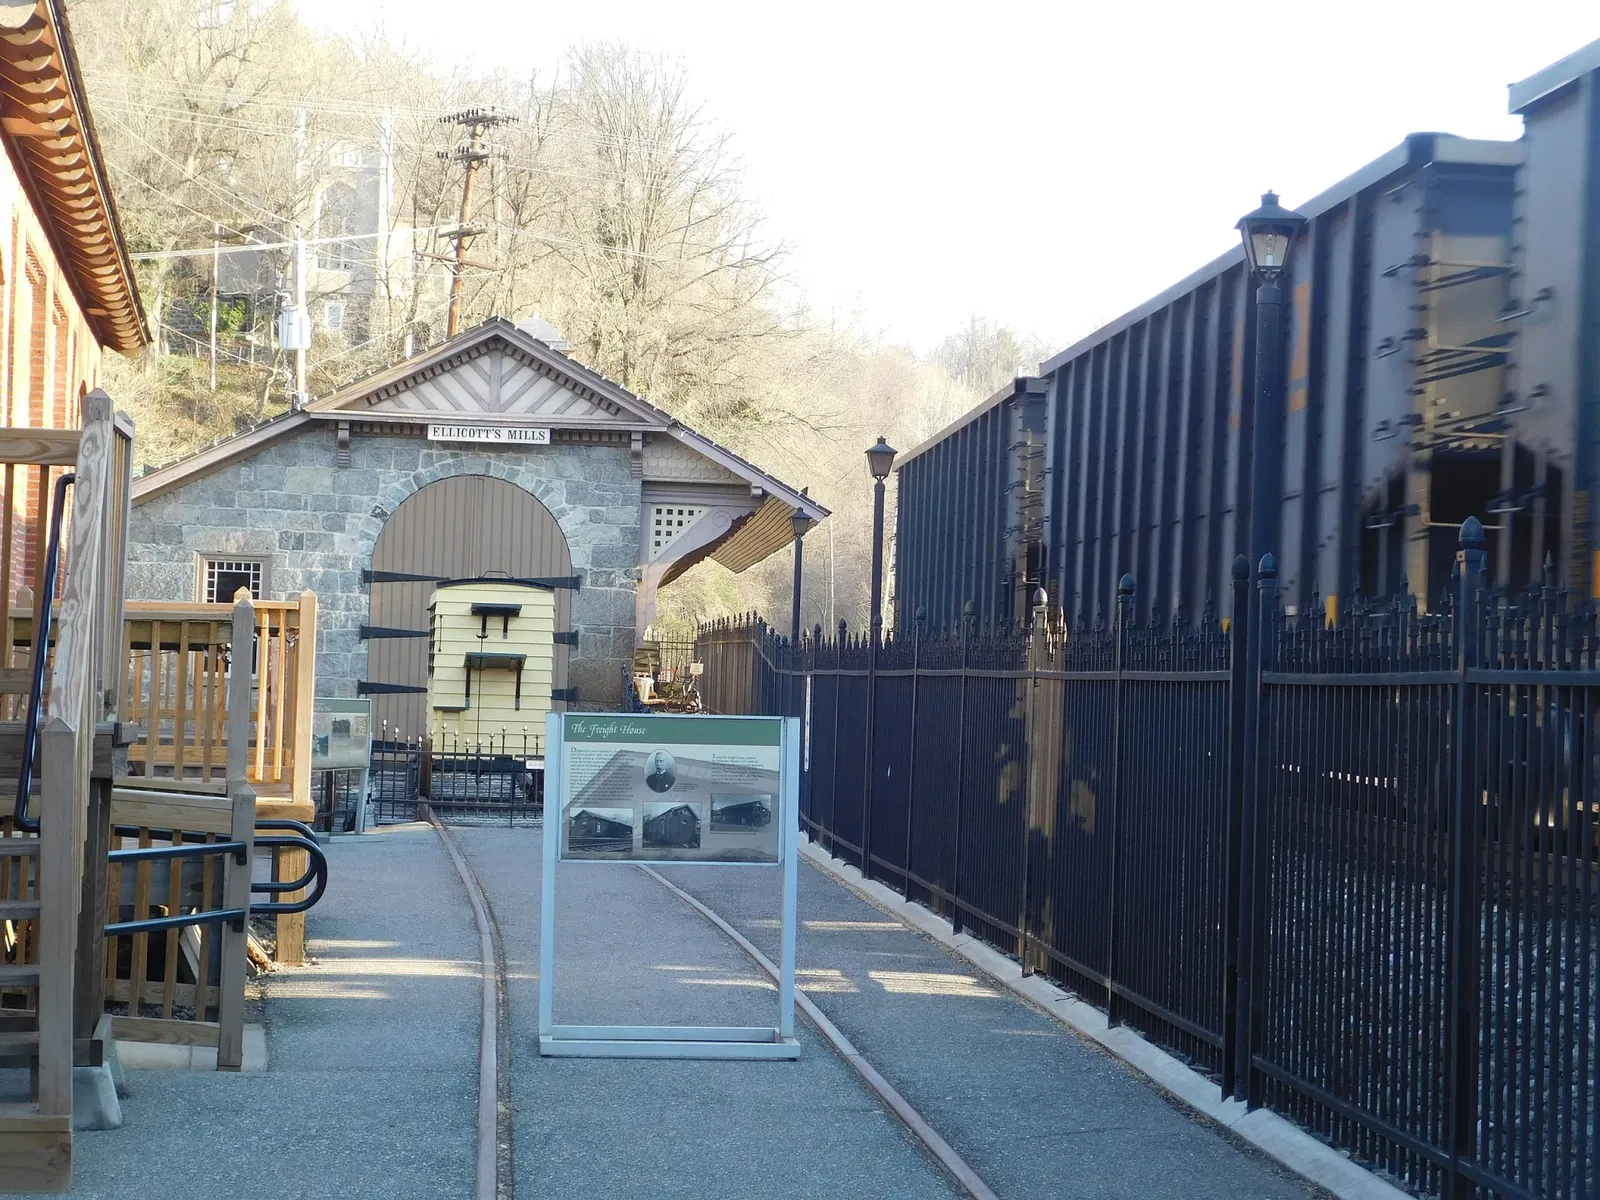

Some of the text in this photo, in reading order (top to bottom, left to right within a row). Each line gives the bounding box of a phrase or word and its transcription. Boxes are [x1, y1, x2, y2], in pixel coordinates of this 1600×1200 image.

[433, 427, 545, 440] ELLICOTT'S MILLS
[571, 720, 646, 738] The Freight House
